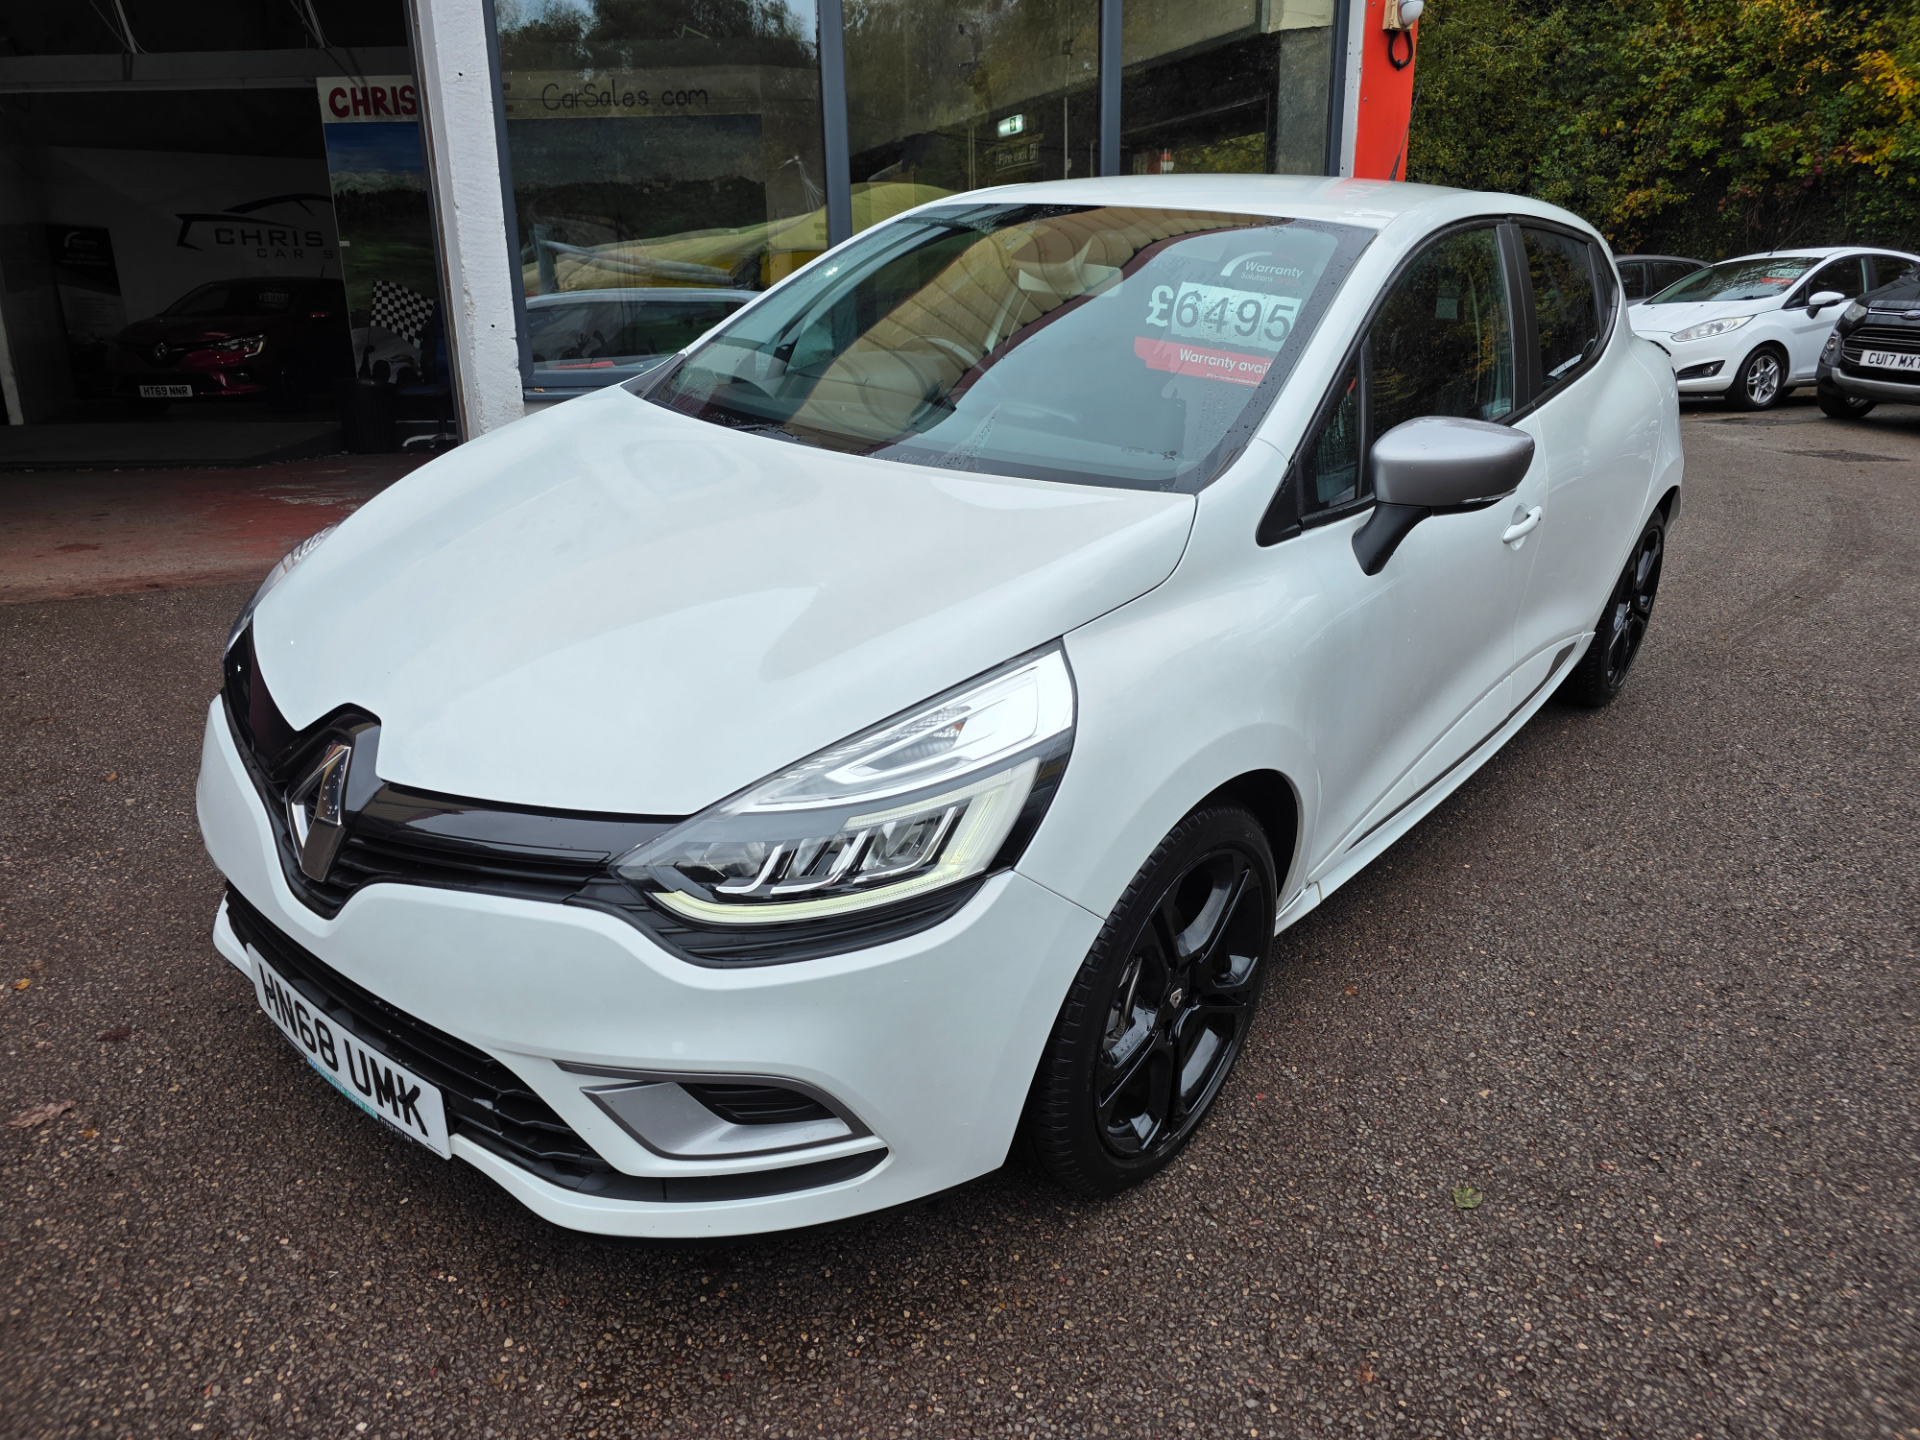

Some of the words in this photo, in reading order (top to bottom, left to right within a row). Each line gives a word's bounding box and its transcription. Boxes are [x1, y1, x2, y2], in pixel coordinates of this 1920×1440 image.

[328, 85, 417, 118] CHRIS
[215, 228, 324, 247] CHRIS
[1241, 271, 1274, 283] Solutions
[1245, 261, 1304, 279] Warranty
[1146, 285, 1295, 343] £6495
[1180, 348, 1237, 372] Warranty
[1868, 352, 1897, 366] CU17
[143, 386, 168, 396] HT69
[169, 385, 189, 396] NNR
[257, 961, 339, 1073] HN68
[343, 1037, 429, 1138] UMK
